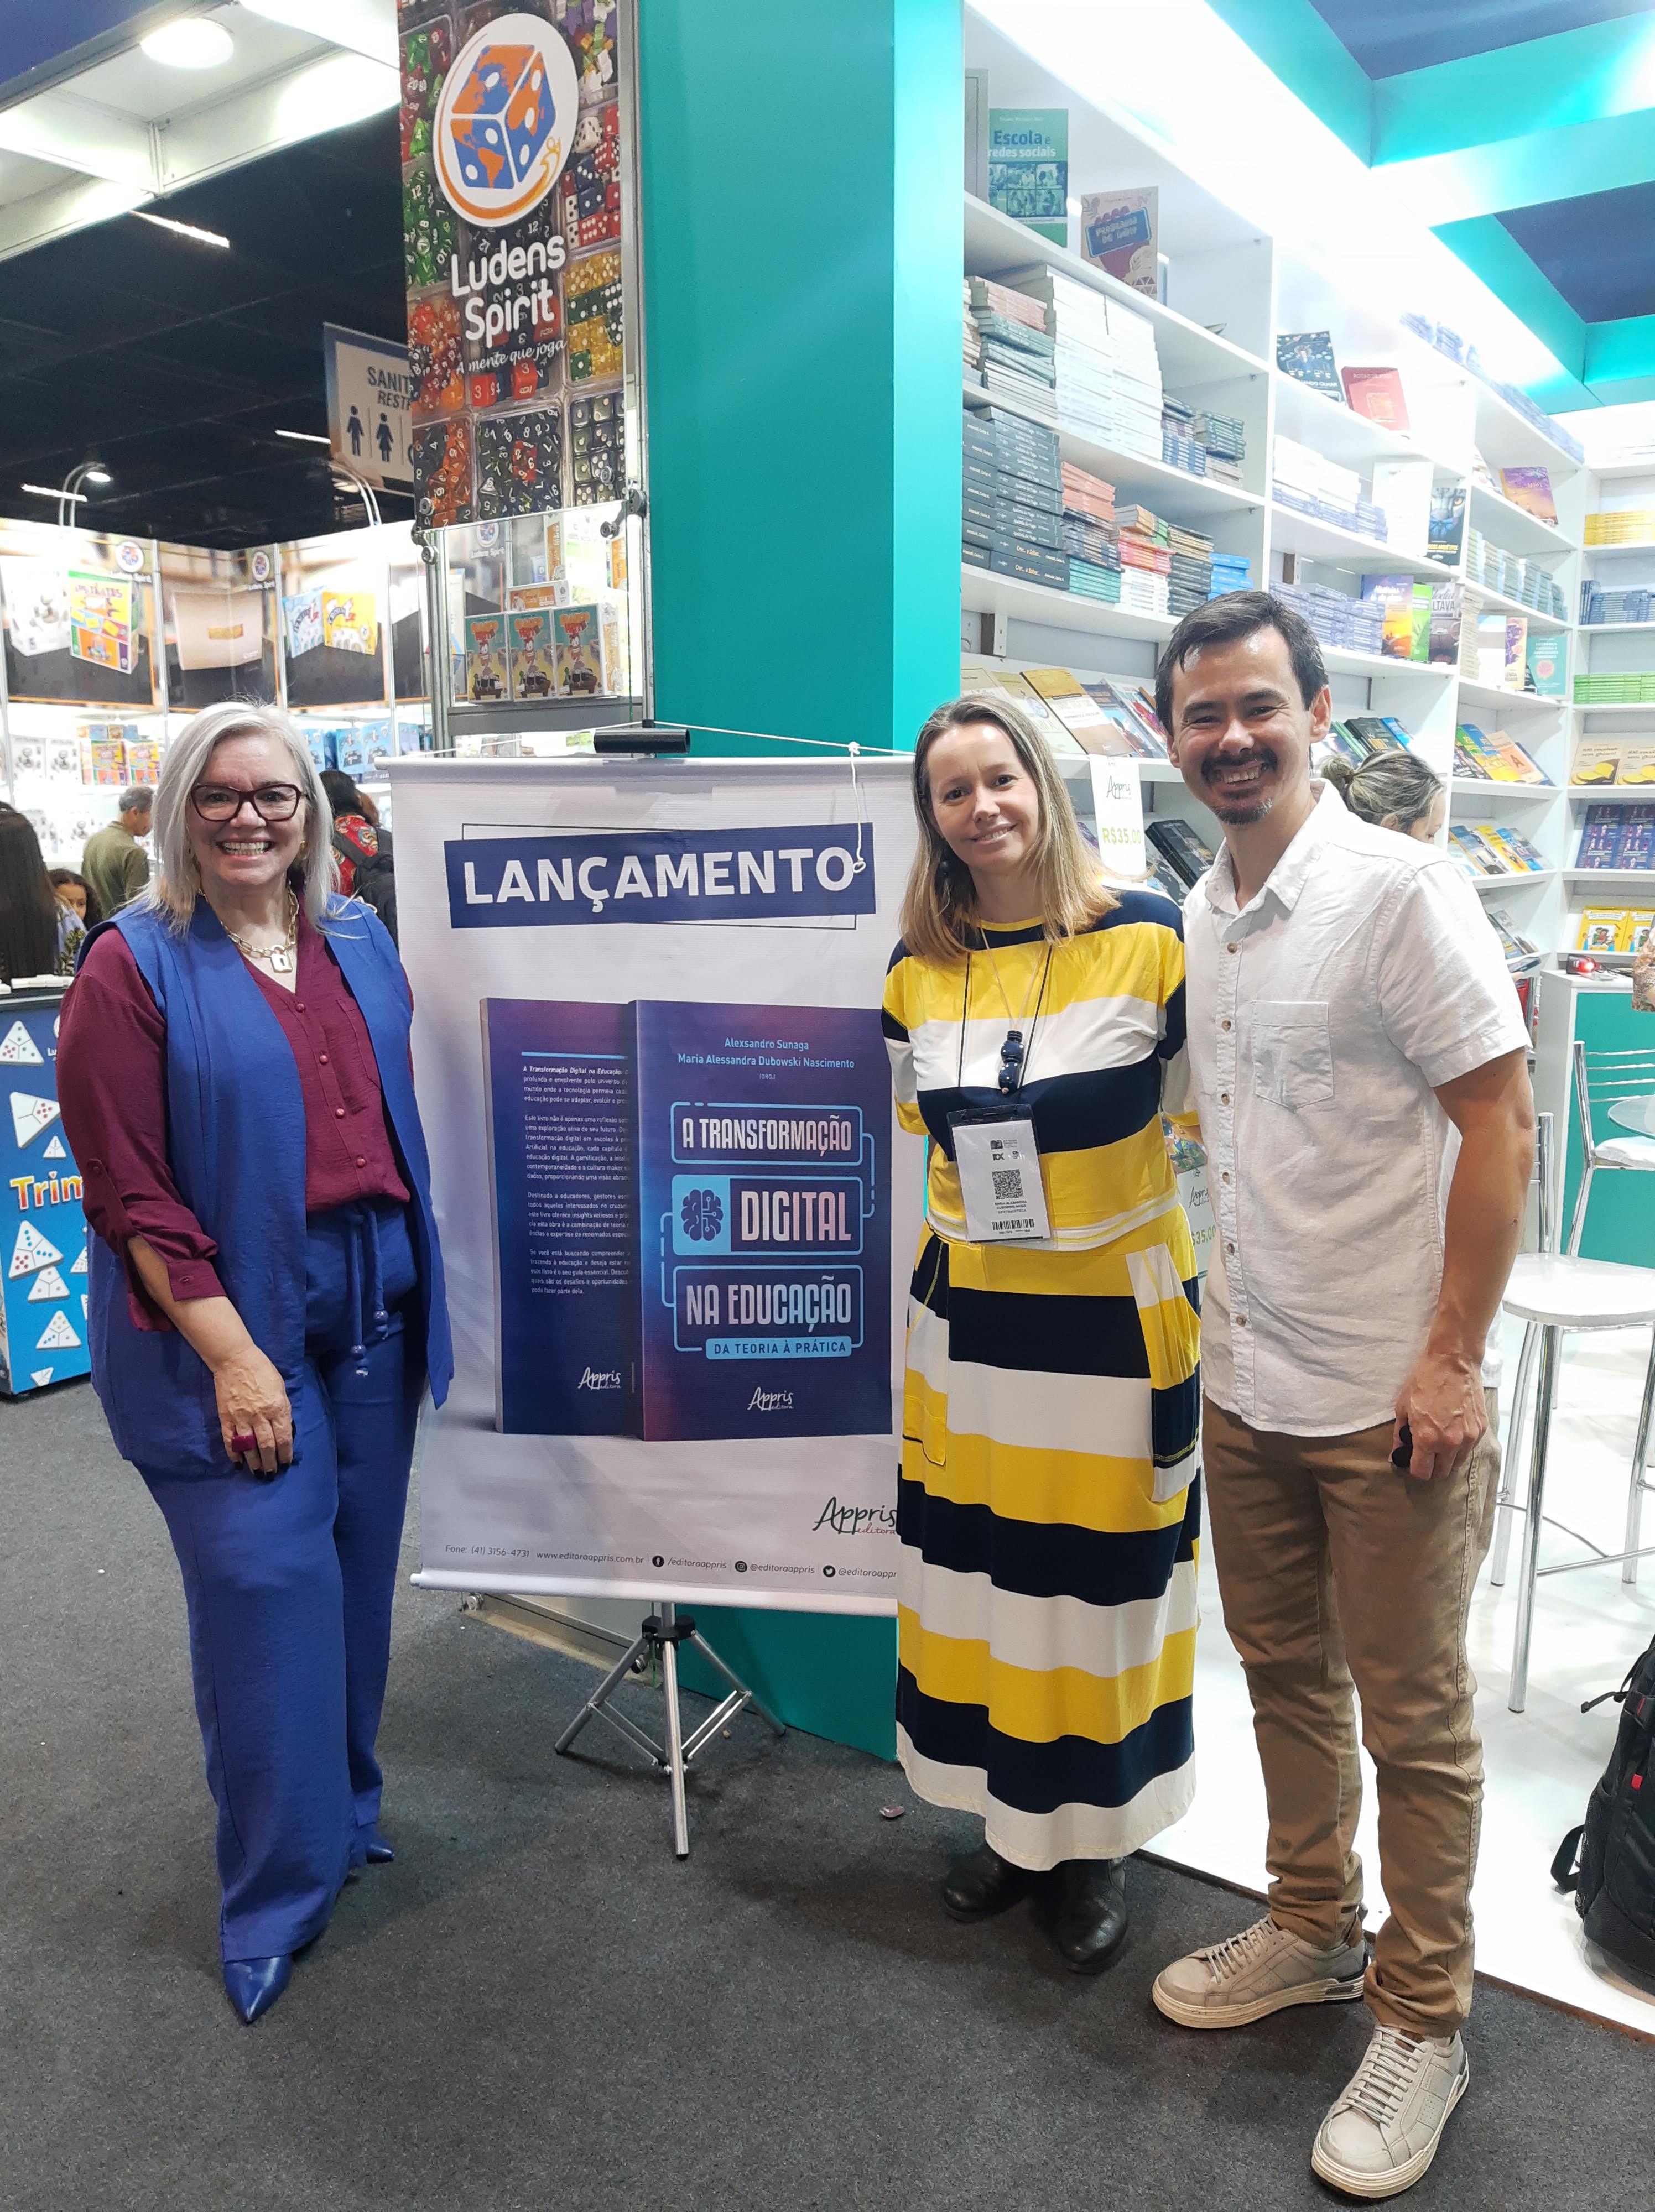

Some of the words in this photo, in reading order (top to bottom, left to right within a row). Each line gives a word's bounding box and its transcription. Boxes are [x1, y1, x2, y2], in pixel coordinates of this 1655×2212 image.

[993, 129, 1042, 145] Escola
[988, 147, 1017, 158] redes
[1019, 145, 1056, 156] sociais
[451, 235, 566, 297] Ludens
[465, 278, 555, 348] Spirit
[456, 363, 465, 374] A
[469, 352, 508, 373] mente
[509, 346, 534, 366] que
[534, 338, 568, 358] joga
[368, 366, 410, 396] SANIT
[1432, 601, 1455, 611] LTAVA
[1107, 775, 1131, 799] Appris
[1102, 827, 1141, 846] R$35,00
[464, 846, 854, 913] LANÇAMENTO
[724, 1038, 774, 1049] Alexsandro
[777, 1040, 809, 1051] Sunaga
[530, 1066, 568, 1074] Transformação
[678, 1054, 704, 1064] Maria
[706, 1055, 756, 1066] Alessandra
[758, 1056, 801, 1067] Dubowski
[803, 1057, 855, 1068] Nascimento
[682, 1118, 694, 1148] A
[699, 1115, 852, 1156] TRANSFORMAÇÃO
[9, 1171, 83, 1211] Trim
[741, 1191, 851, 1241] DIGITAL
[1192, 1224, 1216, 1245] $35,00
[686, 1285, 719, 1325] NA
[728, 1275, 851, 1332] EDUCAÇÃO
[715, 1343, 730, 1354] DA
[735, 1342, 778, 1354] TEORIA
[783, 1340, 791, 1353] À
[796, 1339, 846, 1353] PRÁTICA
[577, 1366, 621, 1390] Appris
[747, 1386, 794, 1411] Appris
[811, 1496, 897, 1535] Appris
[856, 1521, 896, 1535] editora
[445, 1545, 467, 1553] Fone:
[471, 1546, 486, 1555] (41)
[487, 1547, 530, 1558] 3156-4731
[536, 1551, 644, 1564] www.editoraappris.com.br
[668, 1557, 727, 1570] /editoraappris
[750, 1562, 815, 1574] @editoraappris
[838, 1566, 897, 1578] @editoraappr
